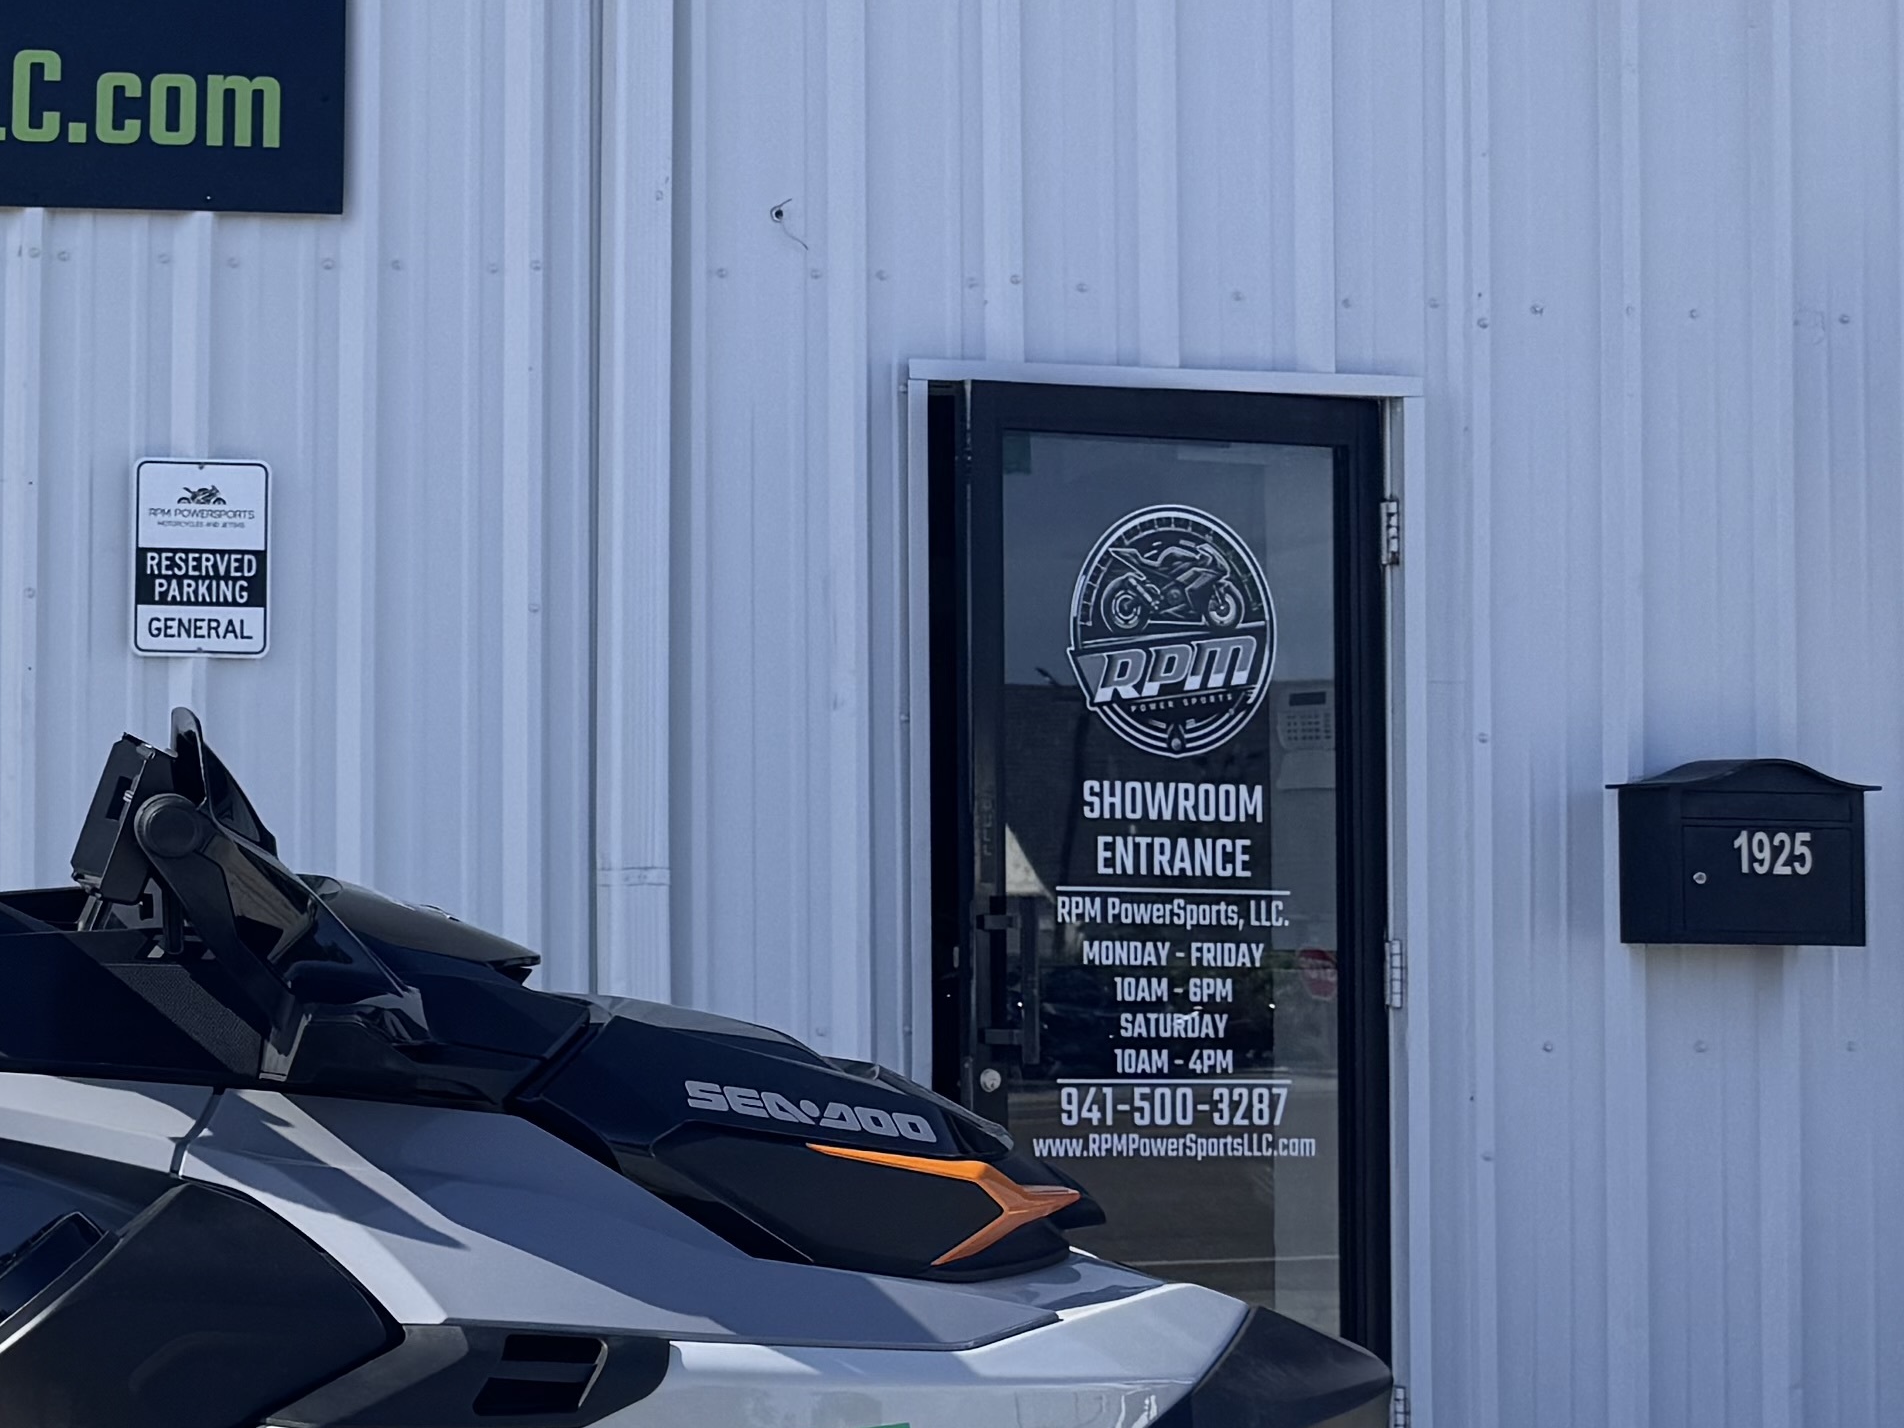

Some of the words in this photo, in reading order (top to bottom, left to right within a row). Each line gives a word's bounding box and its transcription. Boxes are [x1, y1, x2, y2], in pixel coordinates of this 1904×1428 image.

[146, 552, 257, 577] RESERVED
[154, 579, 249, 603] PARKING
[148, 617, 253, 639] GENERAL
[1094, 636, 1257, 703] RPM
[1083, 780, 1264, 823] SHOWROOM
[1097, 835, 1252, 877] ENTRANCE
[1733, 830, 1813, 876] 1925
[1056, 897, 1102, 923] RPM
[1107, 897, 1244, 930] PowerSports,
[1250, 900, 1290, 927] LLC.
[1083, 941, 1171, 966] MONDAY
[1191, 943, 1265, 967] FRIDAY
[1114, 977, 1169, 1002] 10AM
[1188, 978, 1233, 1002] 6PM
[1120, 1013, 1228, 1038] SATURDAY
[1114, 1049, 1169, 1074] 10AM
[1188, 1049, 1233, 1074] 4PM
[1060, 1087, 1288, 1126] 941-500-3287
[1033, 1134, 1316, 1160] www.RPMPowerSportsLLC.com
